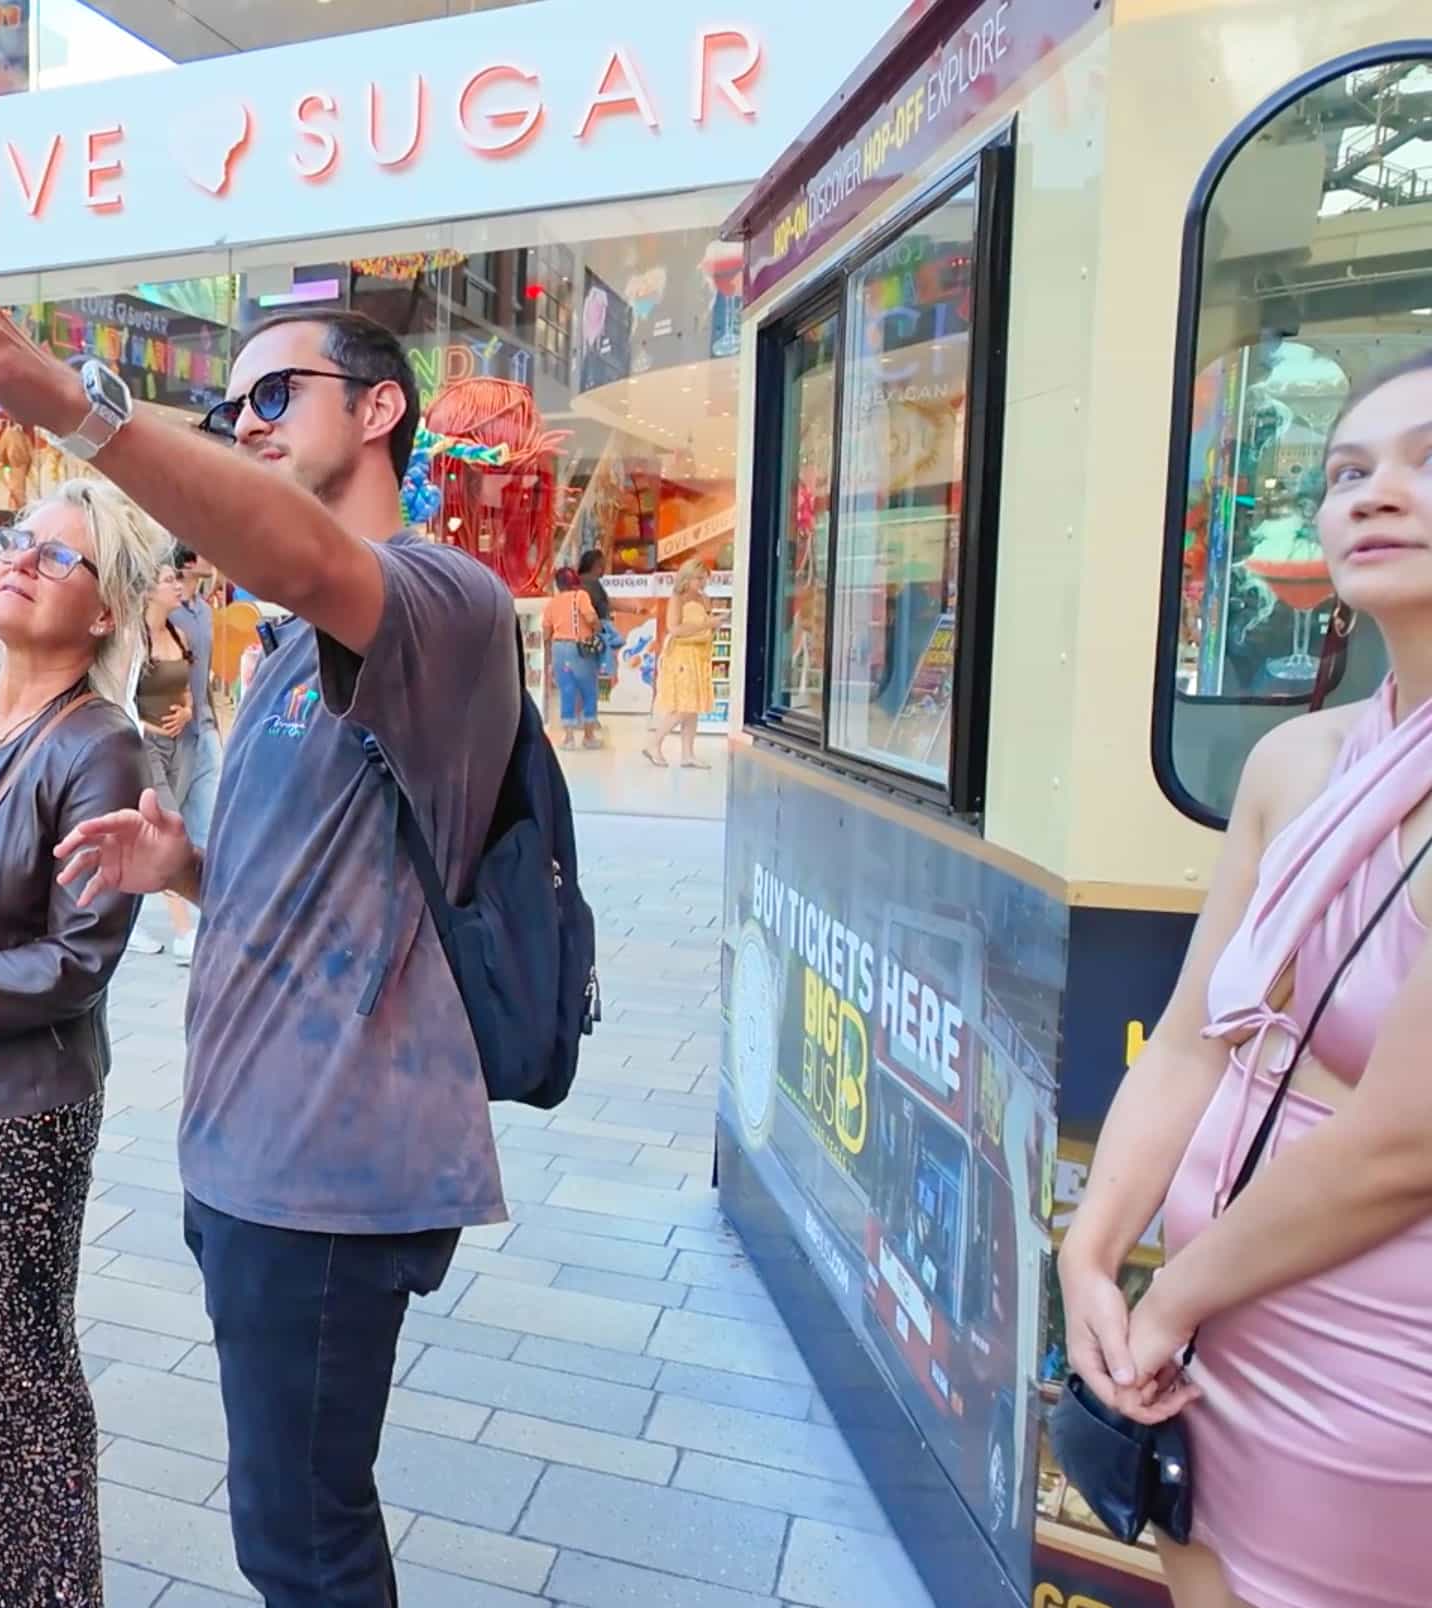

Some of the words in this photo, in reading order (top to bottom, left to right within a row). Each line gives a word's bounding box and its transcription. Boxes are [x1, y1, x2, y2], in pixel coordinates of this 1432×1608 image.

[289, 30, 764, 180] SUGAR
[773, 198, 808, 258] HOP-ON
[806, 150, 862, 229] DISCOVER
[863, 84, 926, 179] HOP-OFF
[927, 2, 1010, 122] EXPLORE
[753, 863, 785, 937] BUY
[786, 887, 874, 1013] TICKETS
[880, 954, 965, 1091] HERE
[802, 967, 837, 1057] BIG
[802, 1037, 835, 1127] BUS
